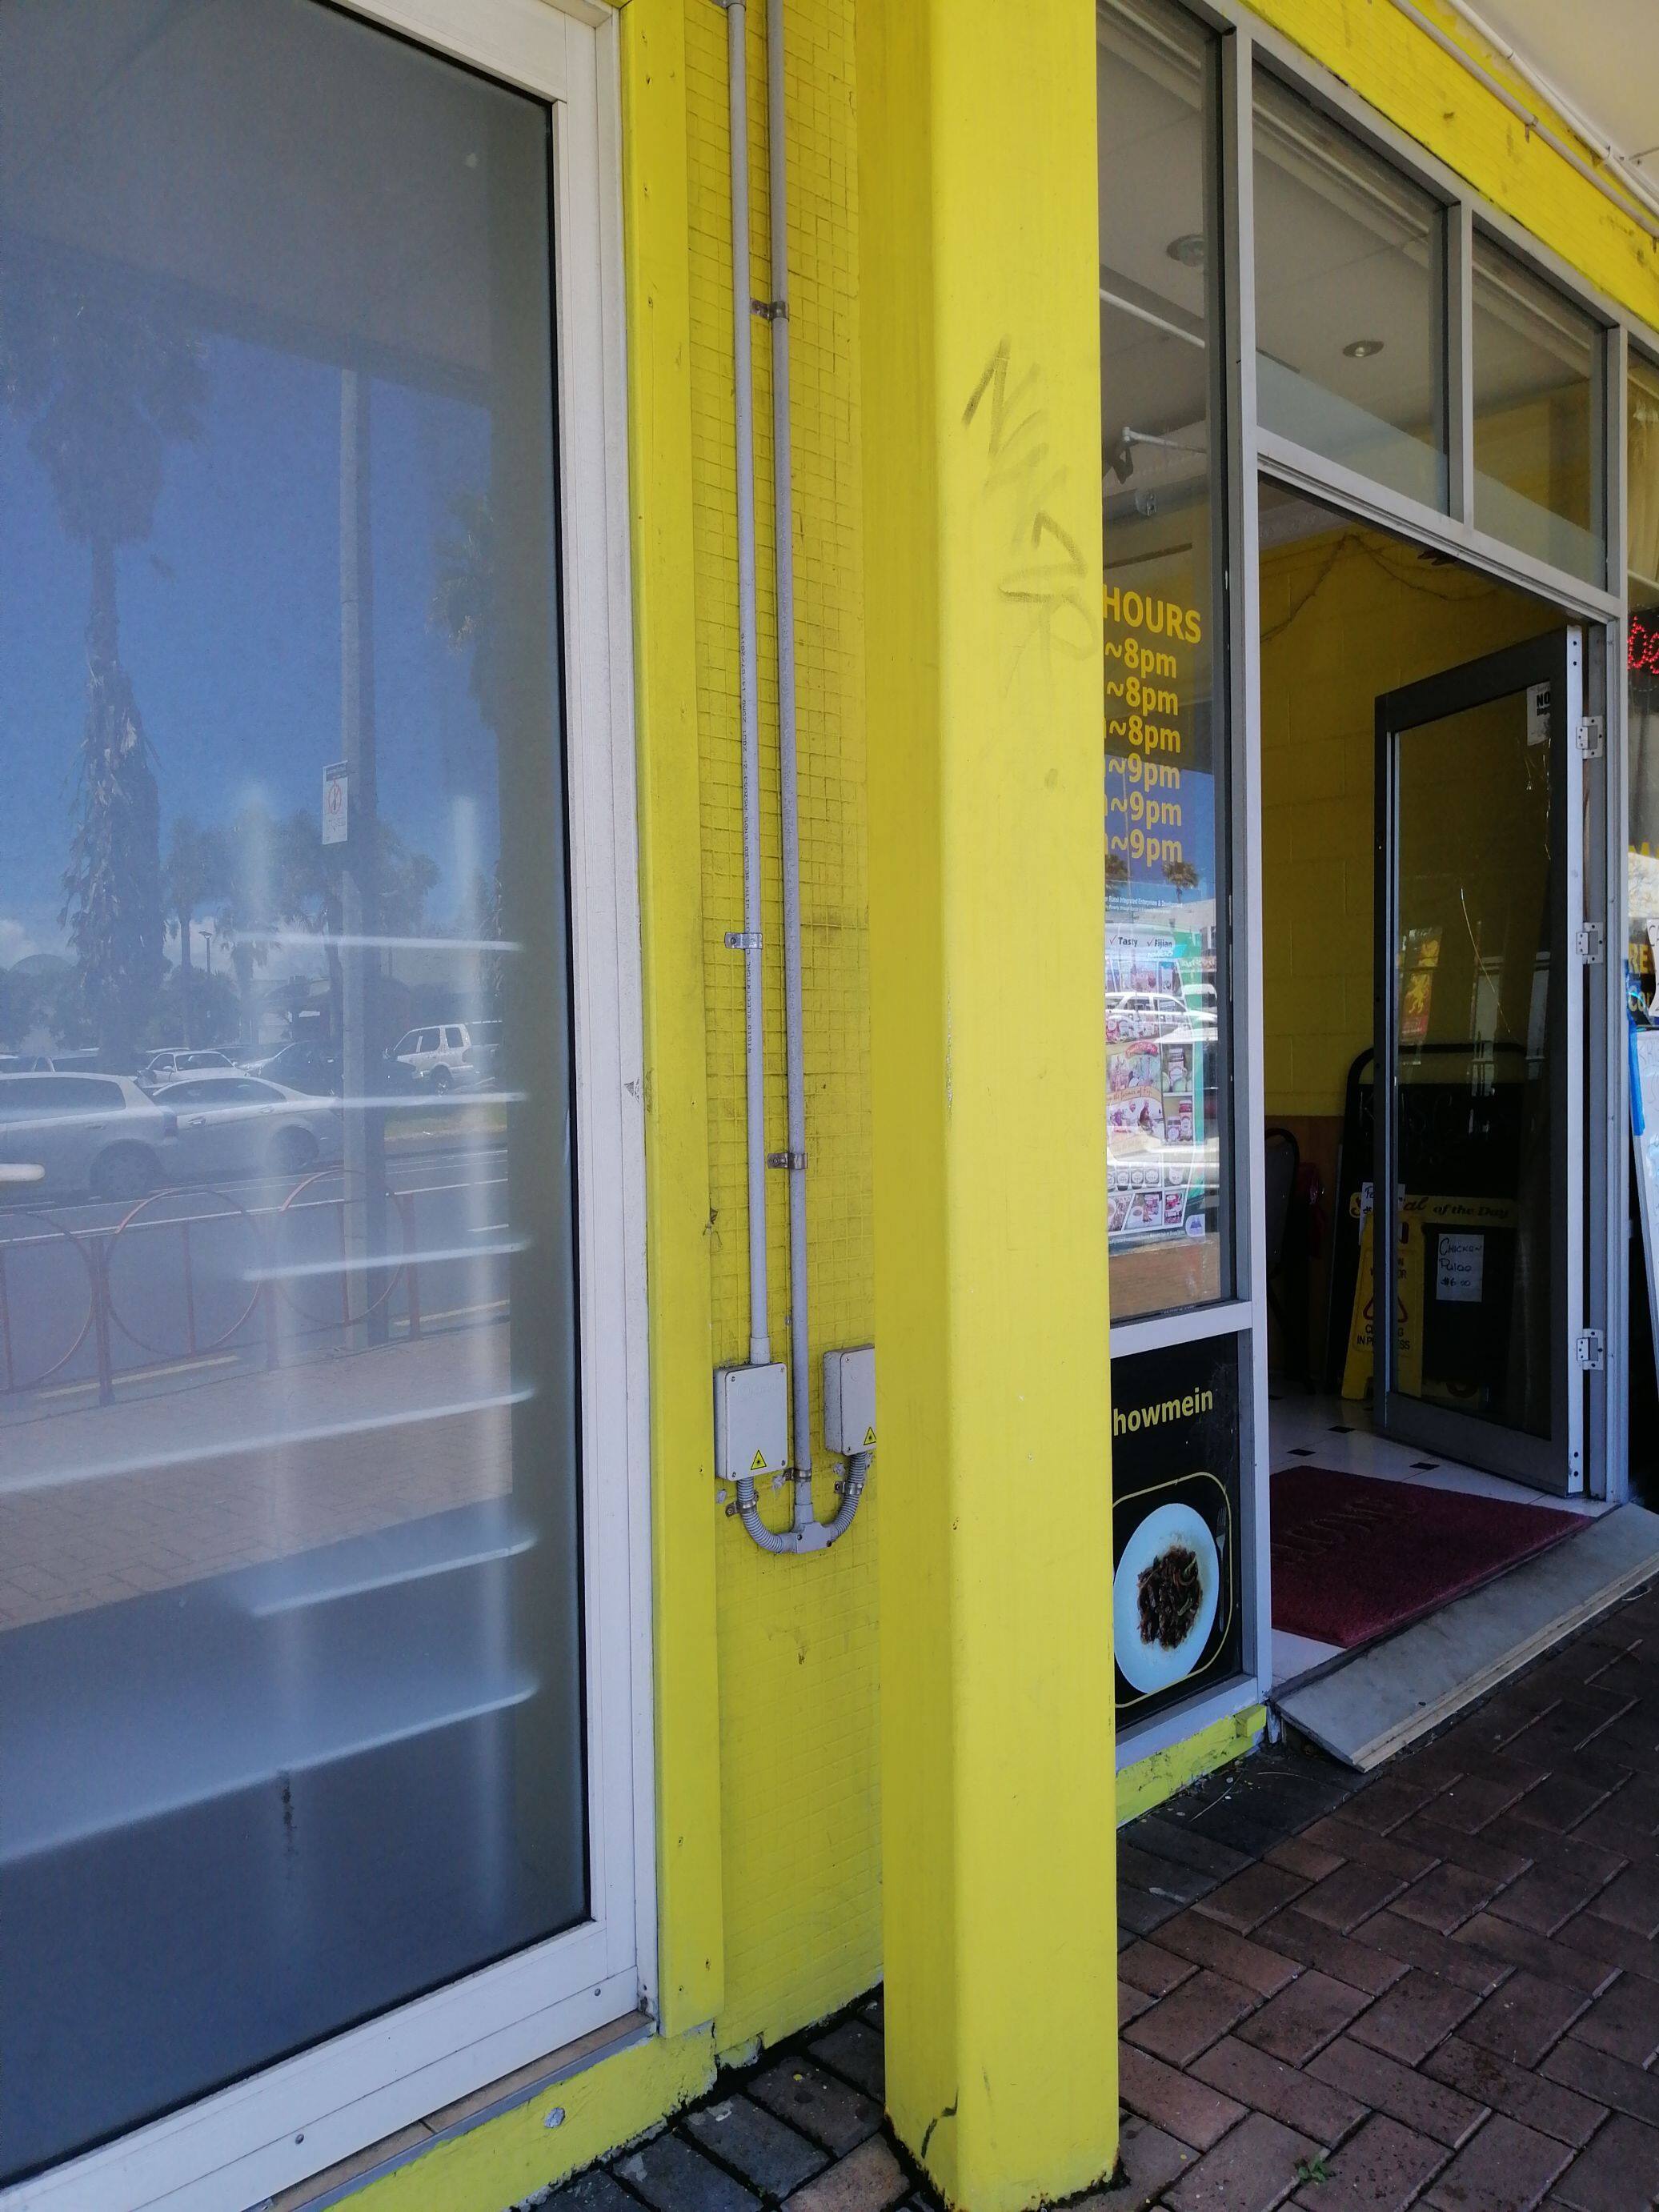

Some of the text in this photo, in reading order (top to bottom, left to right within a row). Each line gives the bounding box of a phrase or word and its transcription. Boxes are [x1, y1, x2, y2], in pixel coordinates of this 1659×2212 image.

[1103, 584, 1201, 643] HOURS
[1105, 638, 1176, 679] ~8pm
[1107, 676, 1178, 716] ~8pm
[1104, 715, 1180, 755] ~8pm
[1104, 753, 1180, 792] ~9pm
[1104, 791, 1181, 830] ~9pm
[1104, 828, 1182, 868] ~9pm
[1118, 937, 1172, 949] Tasty Fijian
